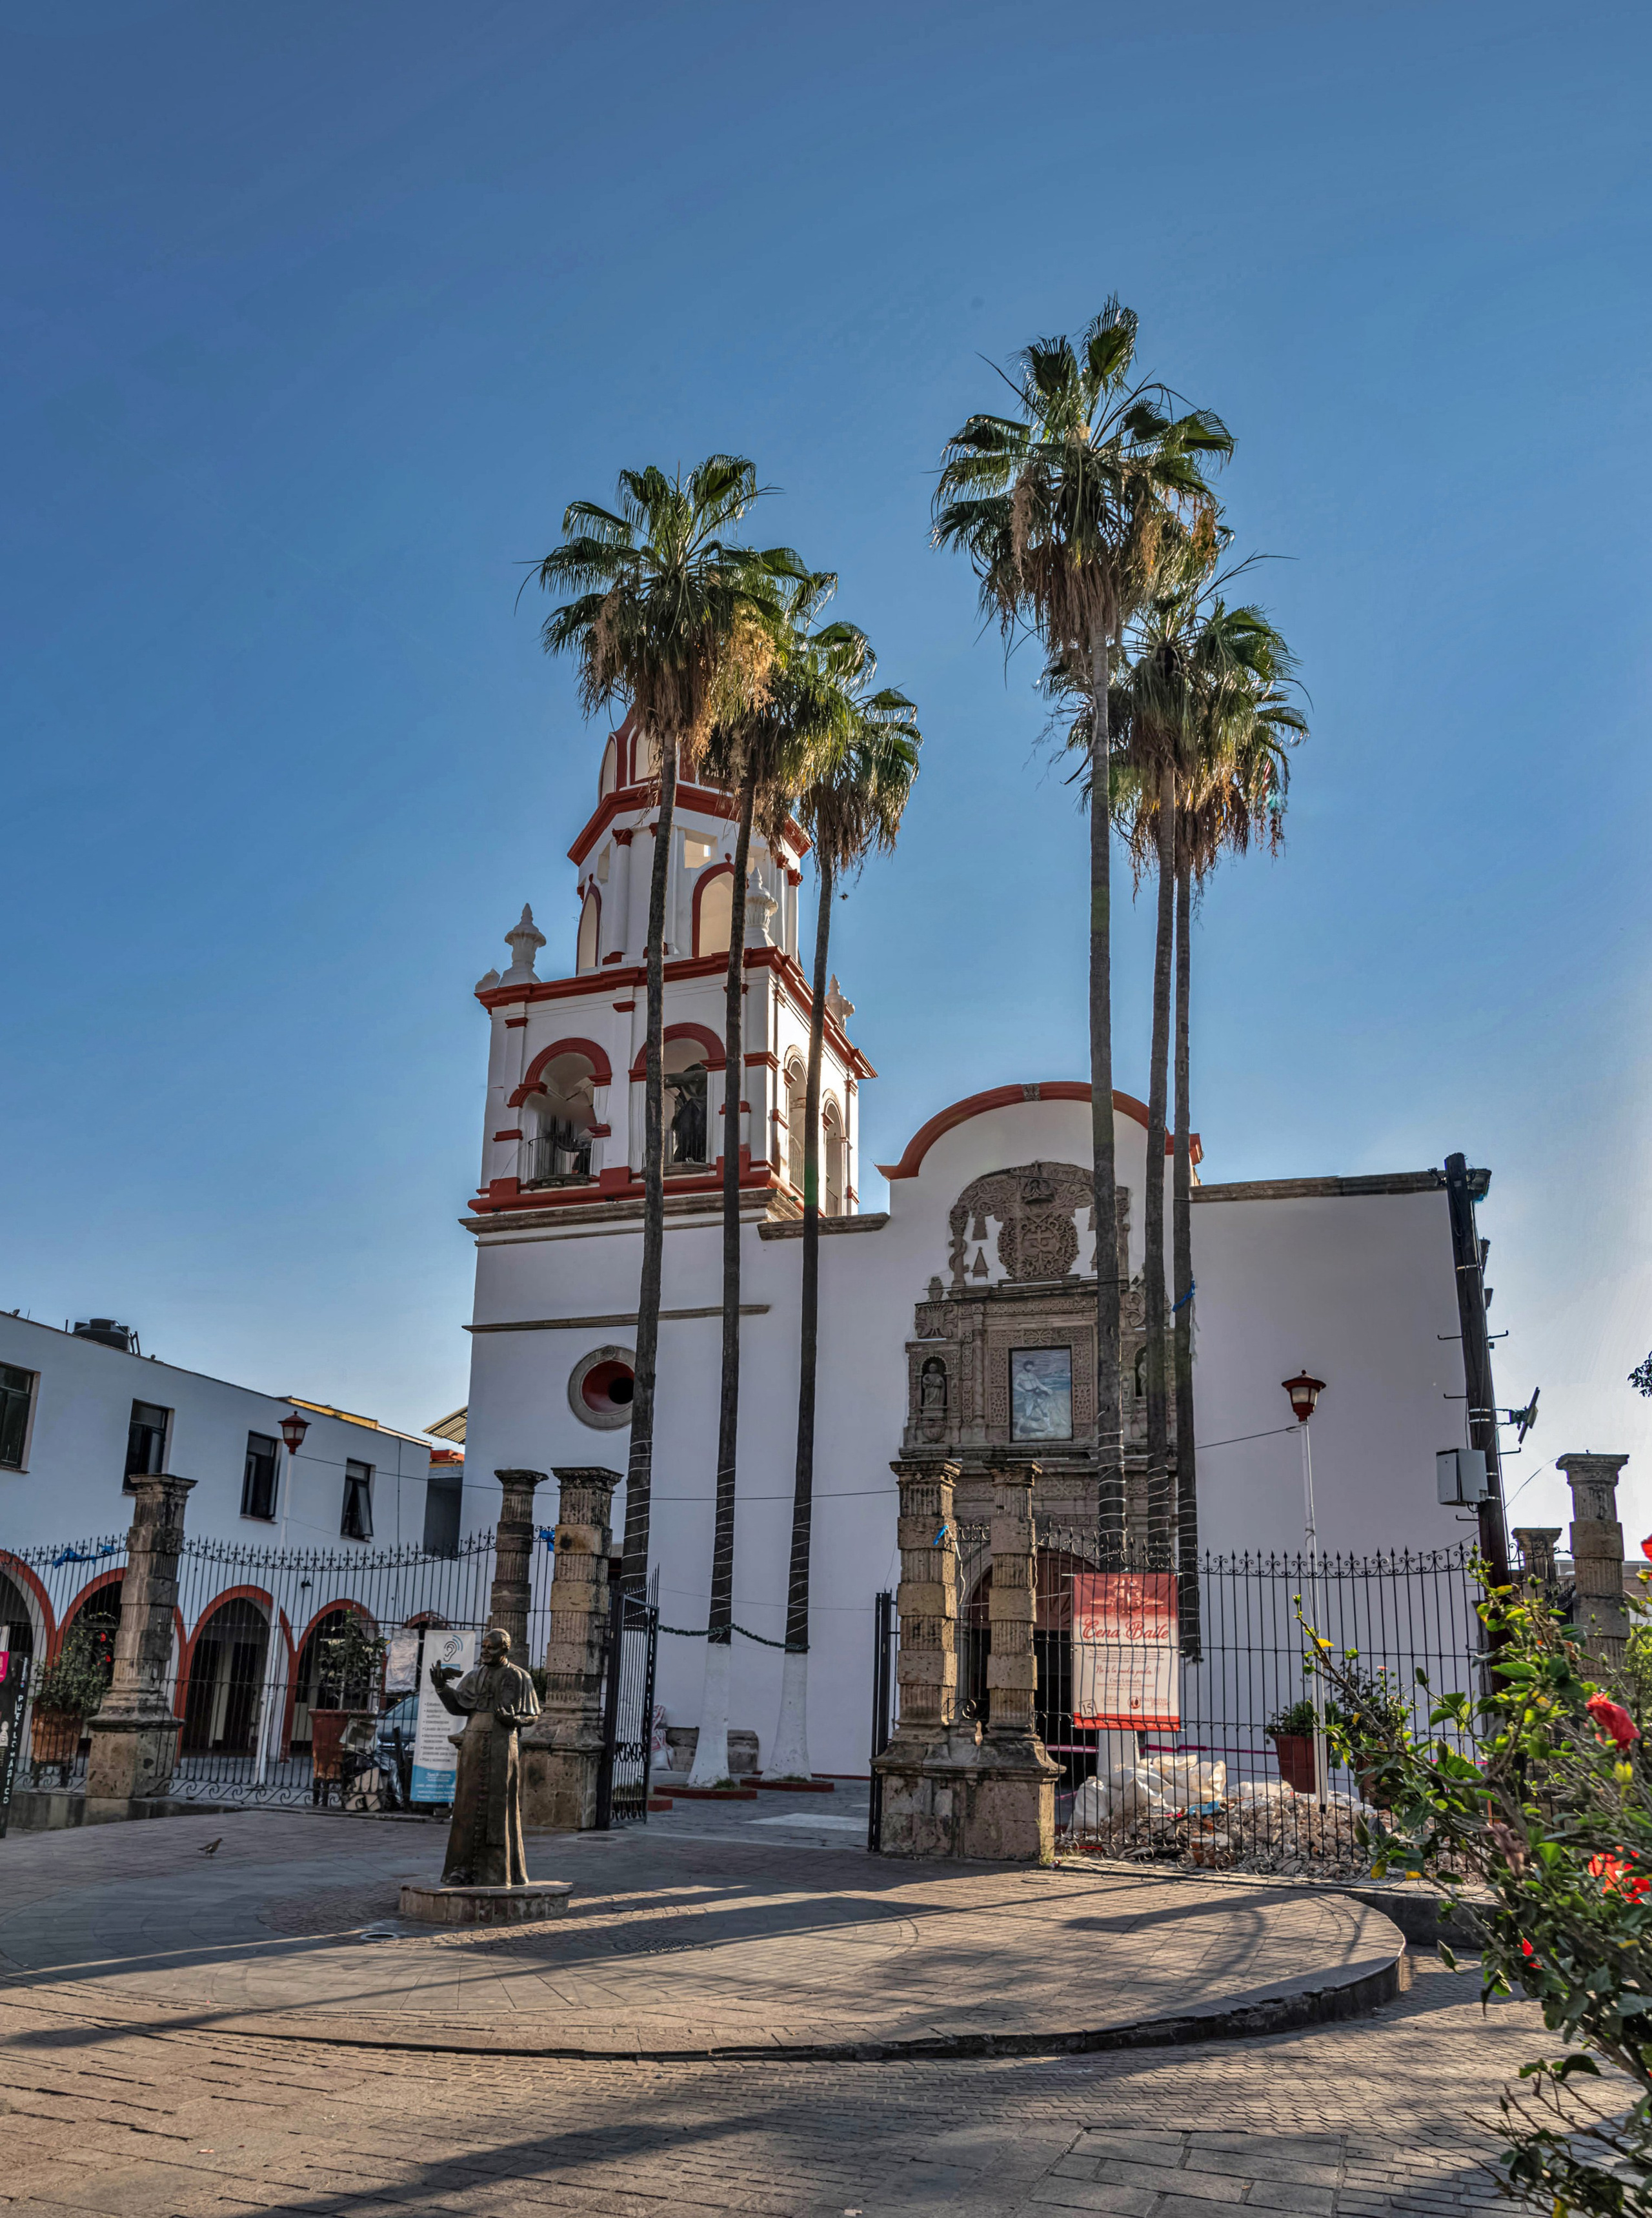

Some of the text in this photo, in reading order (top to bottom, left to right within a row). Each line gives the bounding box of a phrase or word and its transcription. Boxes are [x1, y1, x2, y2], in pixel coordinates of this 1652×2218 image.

[1082, 1618, 1169, 1640] Cena Baile
[1082, 1703, 1093, 1714] 15
